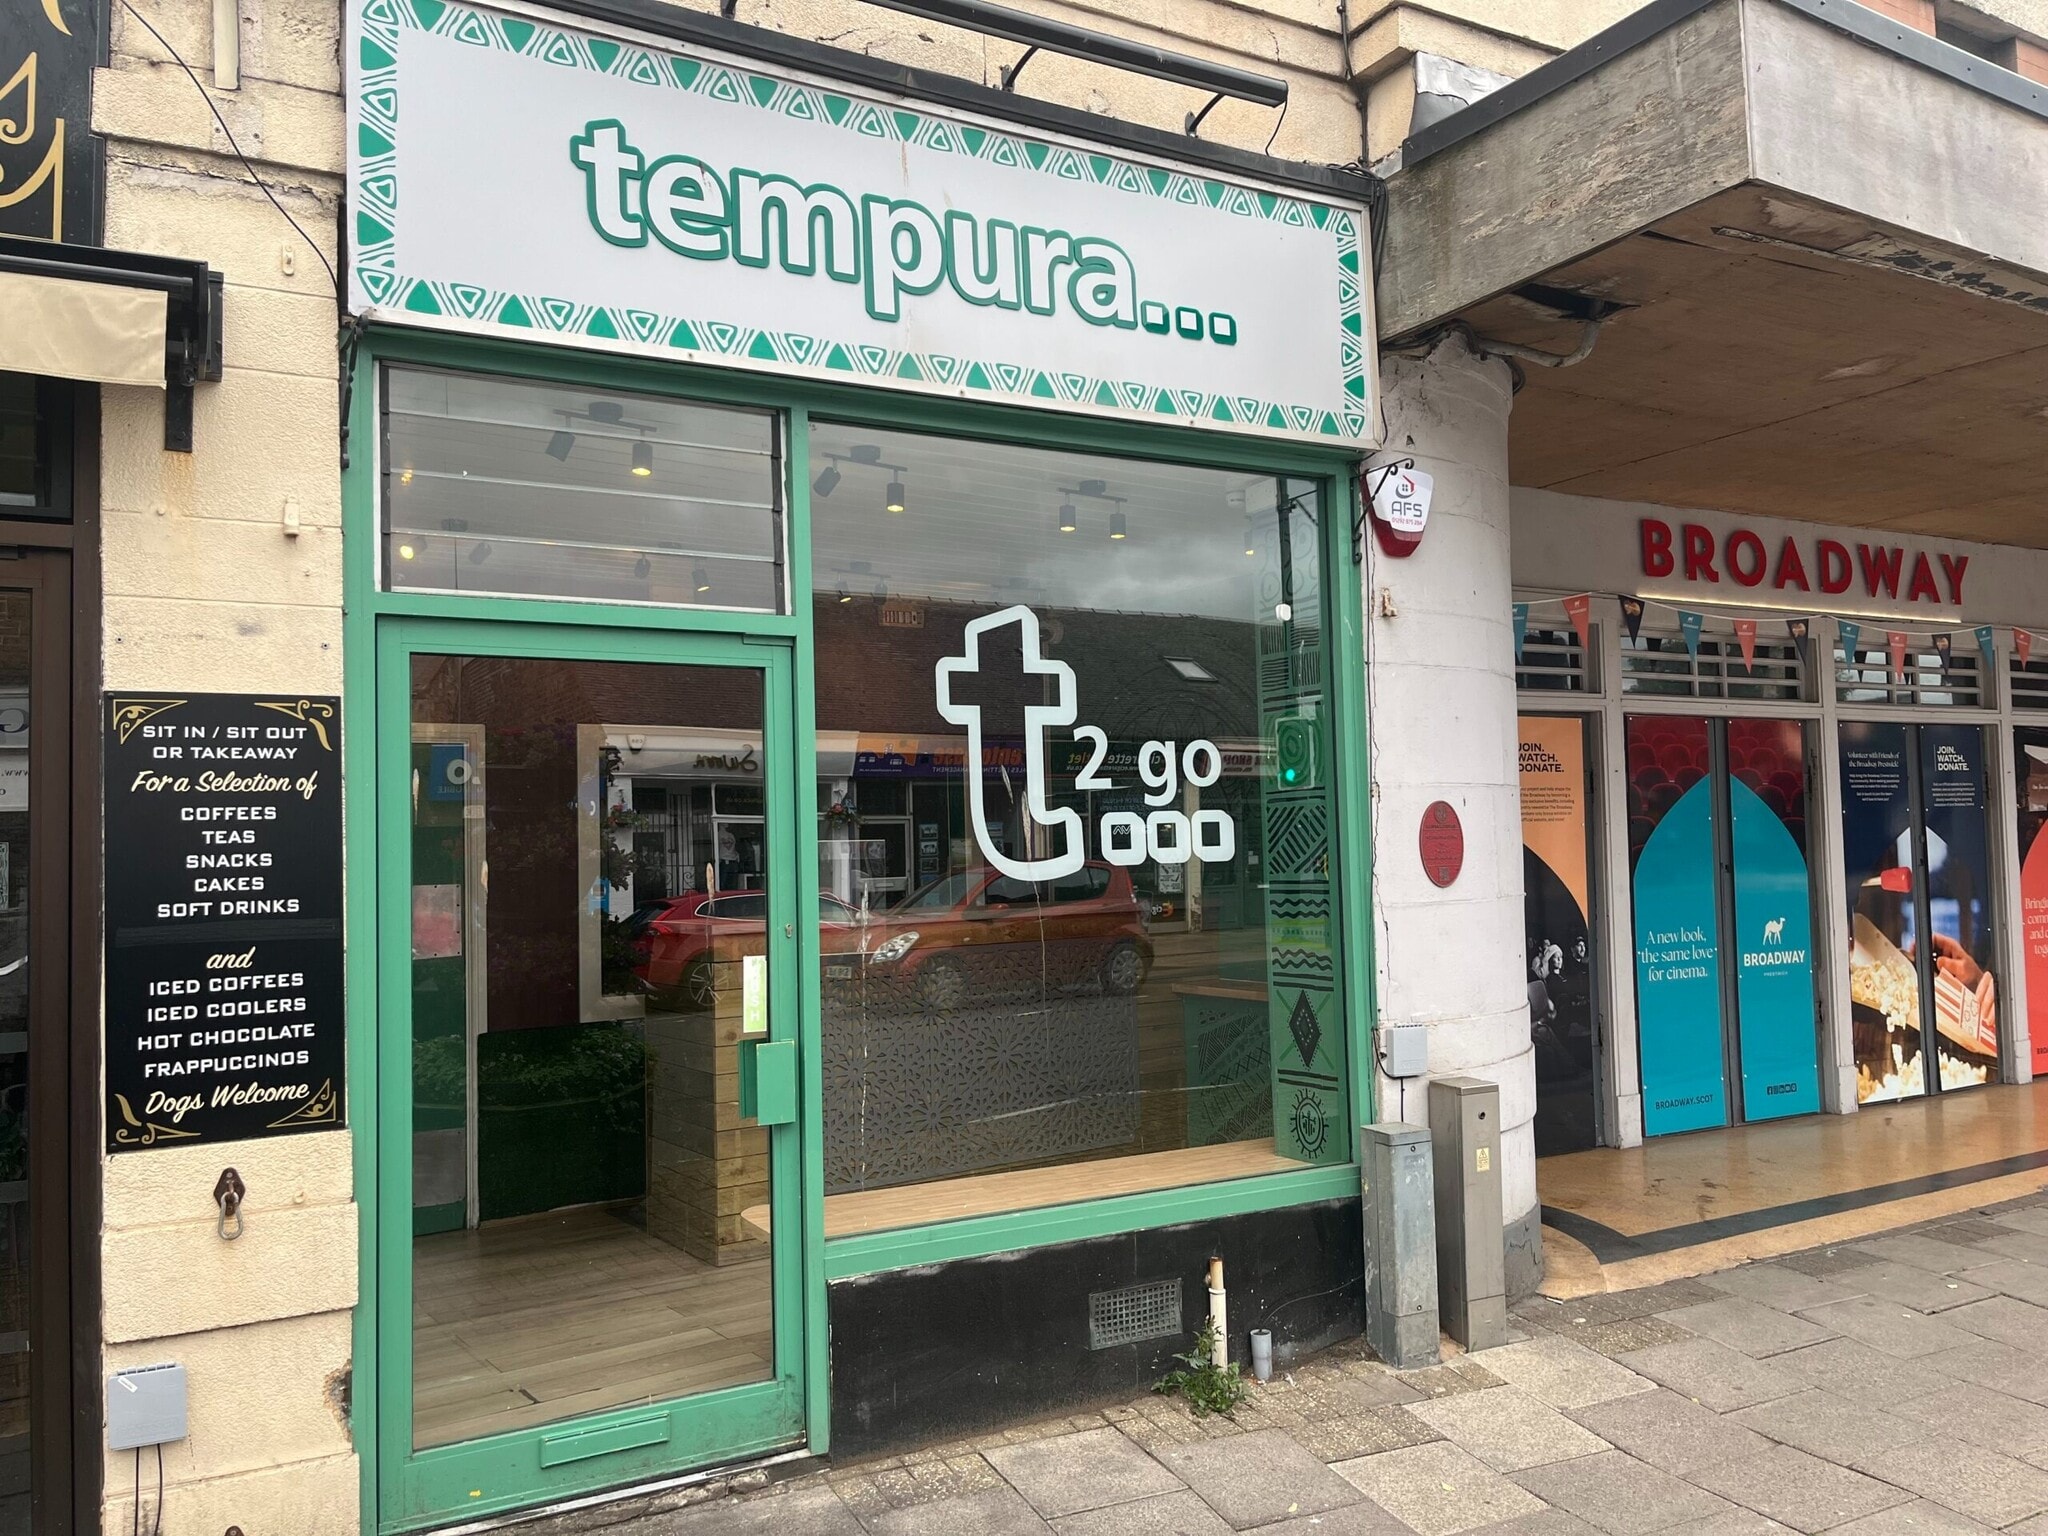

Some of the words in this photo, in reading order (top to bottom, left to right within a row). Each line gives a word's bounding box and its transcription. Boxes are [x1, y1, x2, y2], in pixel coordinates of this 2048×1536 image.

[1391, 501, 1423, 518] AFS
[1641, 518, 1969, 605] BROADWAY
[143, 726, 176, 738] SIT
[184, 726, 205, 738] IN
[212, 726, 219, 738] /
[226, 727, 259, 739] SIT
[266, 727, 308, 739] OUT
[935, 604, 1085, 881] t
[1073, 725, 1112, 790] 2
[1138, 739, 1221, 807] go
[1937, 746, 1956, 754] JOIN.
[153, 747, 183, 759] OR
[190, 747, 298, 760] TAKEAWAY
[1937, 754, 1965, 762] WATCH.
[1938, 762, 1970, 771] DONATE.
[131, 770, 173, 792] For
[174, 778, 190, 792] a
[195, 770, 291, 792] Selection
[296, 770, 318, 800] of
[180, 806, 277, 821] COFFEES
[202, 830, 256, 844] TEAS
[186, 853, 273, 869] SNACKS
[194, 877, 265, 892] CAKES
[157, 902, 213, 918] SOFT
[220, 899, 300, 916] DRINKS
[1646, 931, 1657, 944] A
[1657, 932, 1679, 944] new
[1680, 926, 1707, 943] look,
[206, 945, 256, 969] and
[1641, 947, 1659, 963] the
[1661, 948, 1690, 962] same
[1692, 945, 1714, 960] love
[1743, 950, 1805, 967] BROADWAY
[1648, 966, 1664, 981] for
[1666, 965, 1708, 980] cinema.
[149, 979, 200, 996] ICED
[209, 972, 304, 992] COFFEES
[147, 1005, 198, 1022] ICED
[206, 997, 306, 1018] COOLERS
[137, 1033, 182, 1050] HOT
[190, 1023, 315, 1047] CHOCOLATE
[144, 1050, 310, 1078] FRAPPUCCINOS
[145, 1090, 205, 1123] Dogs
[211, 1081, 310, 1108] Welcome
[1655, 1094, 1714, 1110] BROADWAY.SCOT
